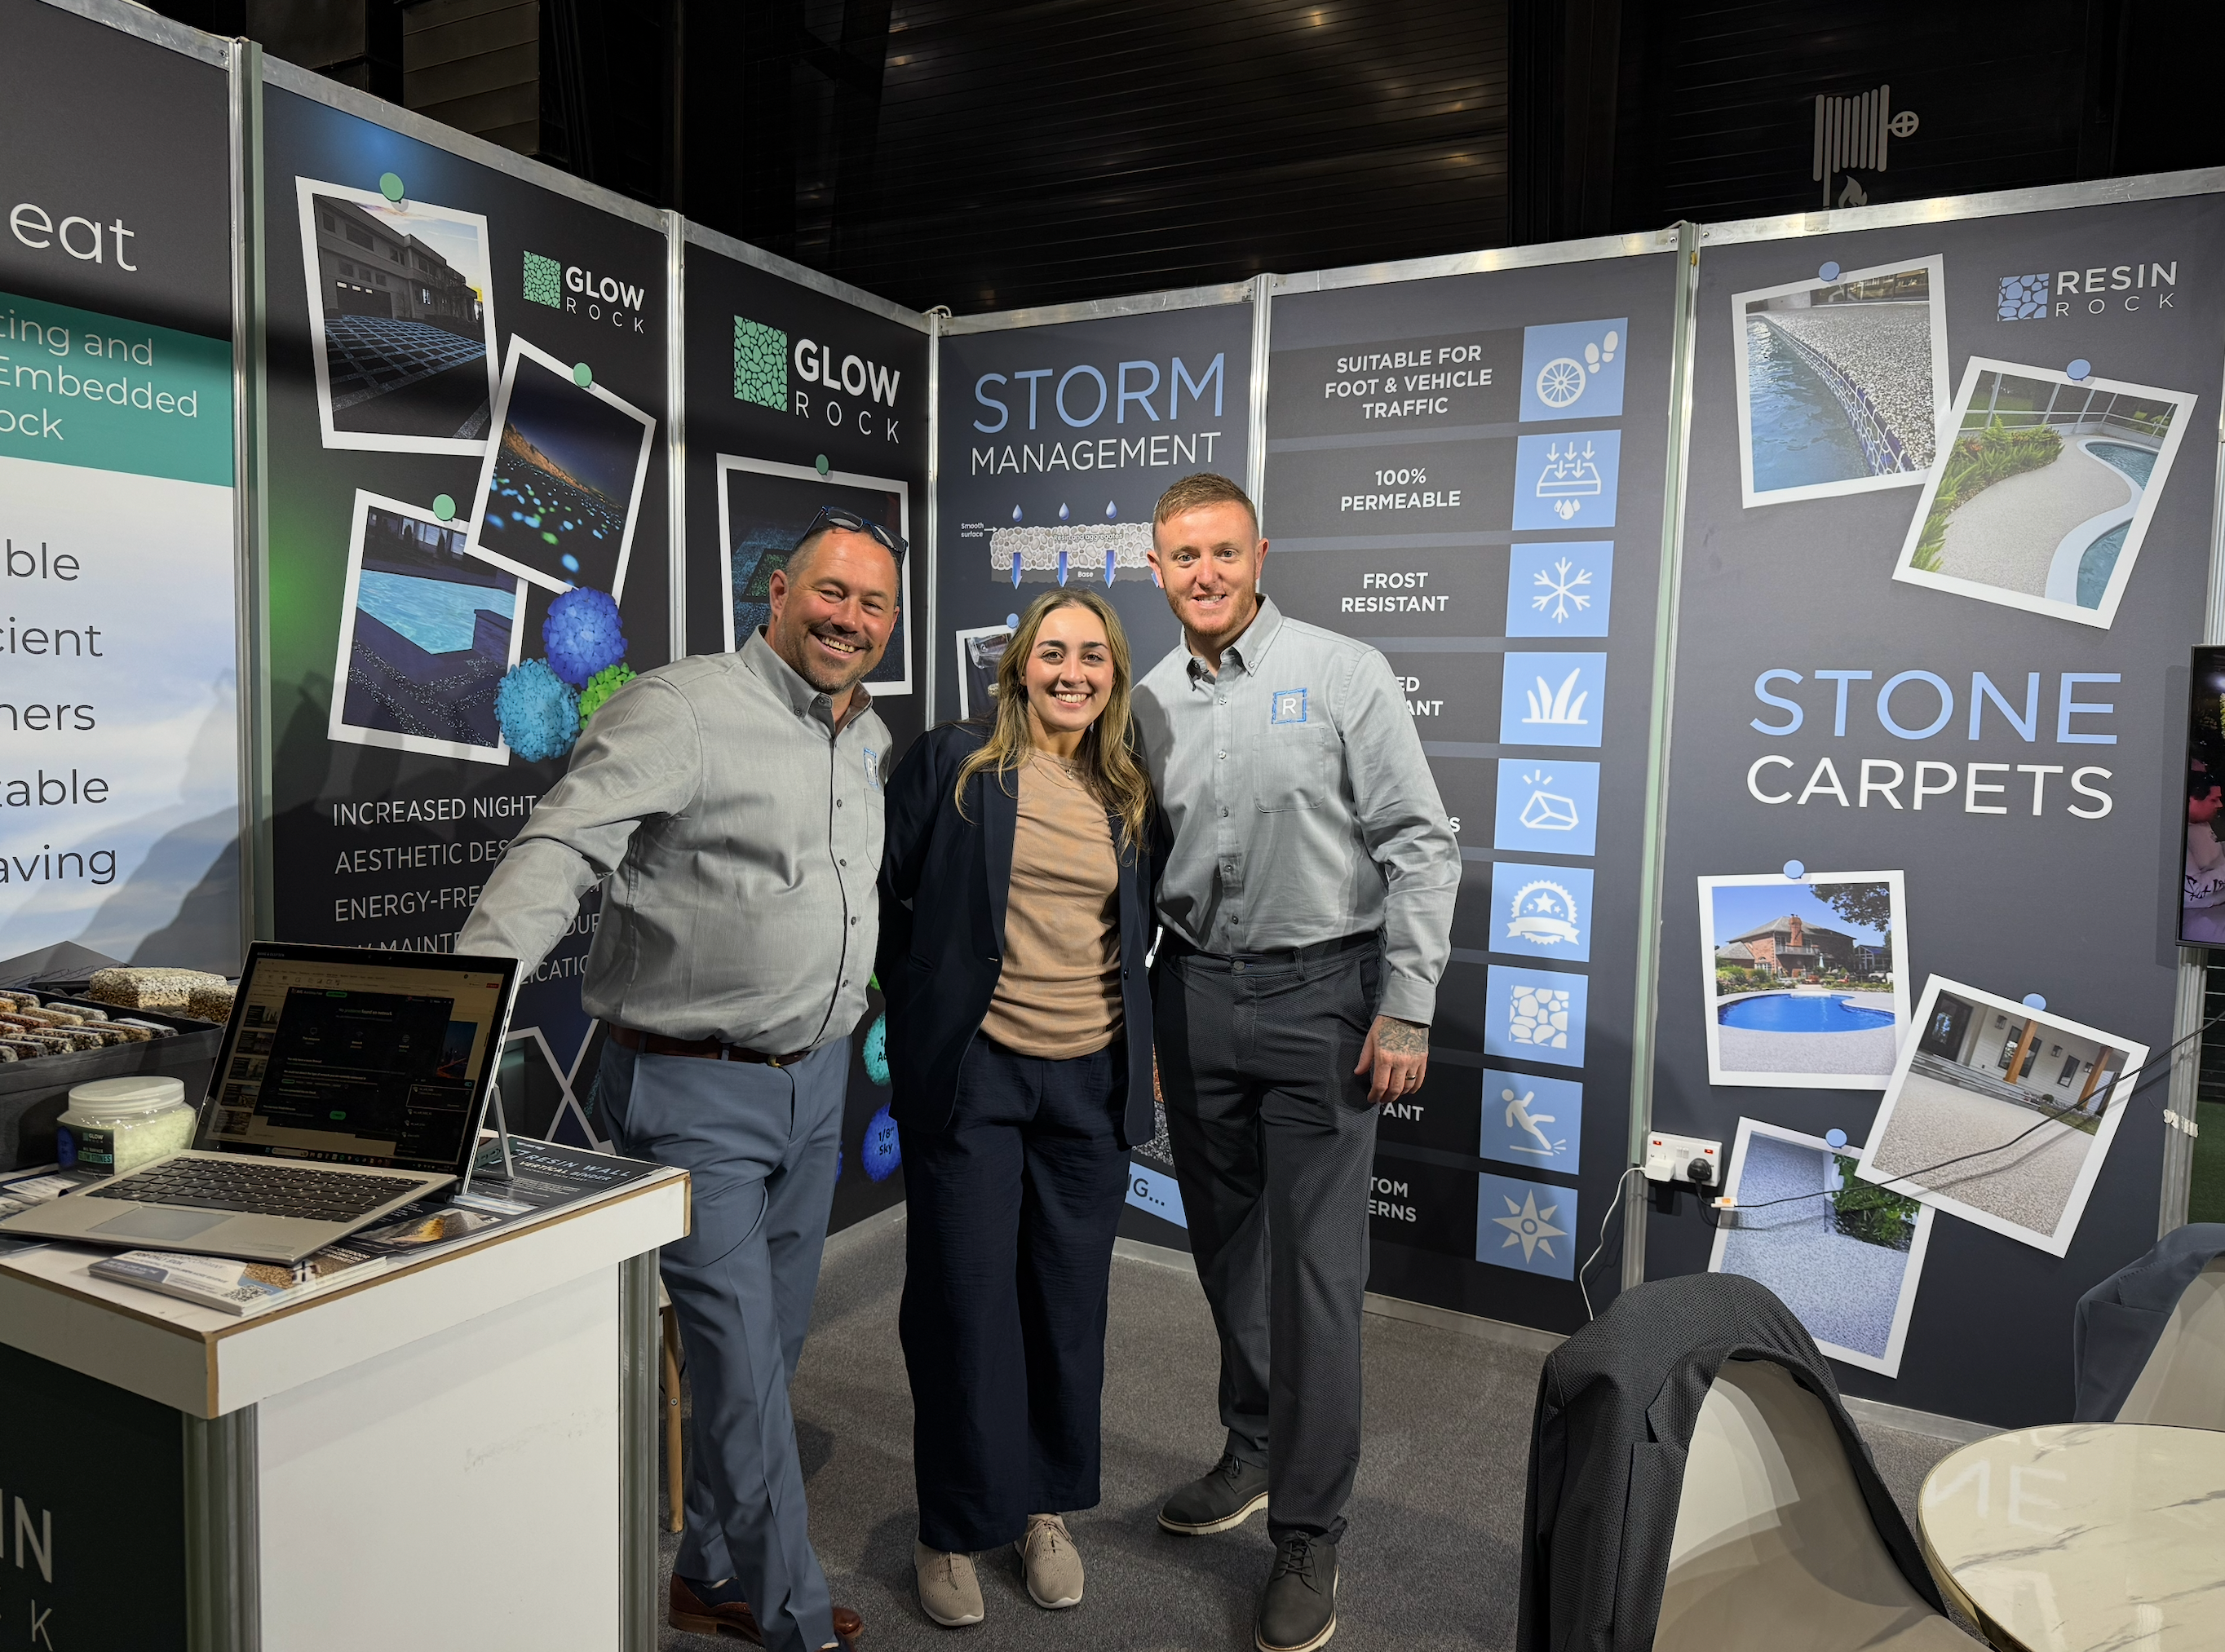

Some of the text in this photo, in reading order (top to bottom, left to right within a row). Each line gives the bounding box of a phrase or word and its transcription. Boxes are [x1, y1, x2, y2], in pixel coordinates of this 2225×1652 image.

[9, 202, 138, 272] eat
[565, 266, 645, 311] GLOW
[2055, 260, 2178, 296] RESIN
[566, 297, 644, 334] ROCK
[2055, 292, 2174, 317] ROCK
[84, 333, 153, 367] and
[1336, 345, 1482, 373] SUITABLE FOR
[794, 338, 900, 408] GLOW
[1325, 369, 1493, 399] FOOT & VEHICLE
[972, 352, 1224, 434] STORM
[1362, 397, 1449, 419] TRAFFIC
[795, 391, 900, 444] ROCK
[971, 431, 1222, 476] MANAGEMENT
[1374, 467, 1427, 486] 100%
[1340, 490, 1461, 512] PERMEABLE
[961, 522, 984, 530] Smooth
[7, 538, 80, 581] ble
[1363, 572, 1429, 590] FROST
[1341, 595, 1449, 613] RESISTANT
[0, 616, 104, 657] ient
[1282, 698, 1297, 715] R
[1749, 668, 2121, 745] STONE
[0, 769, 109, 807] able
[1746, 754, 2114, 820] CARPETS
[333, 795, 537, 827] INCREASED NIGHT
[334, 842, 462, 875] AESTHETIC
[334, 885, 485, 922] ENERGY-FRE
[524, 1154, 631, 1177] RESIN WALL
[879, 1142, 893, 1156] Sky
[519, 1160, 568, 1174] VERTICAL
